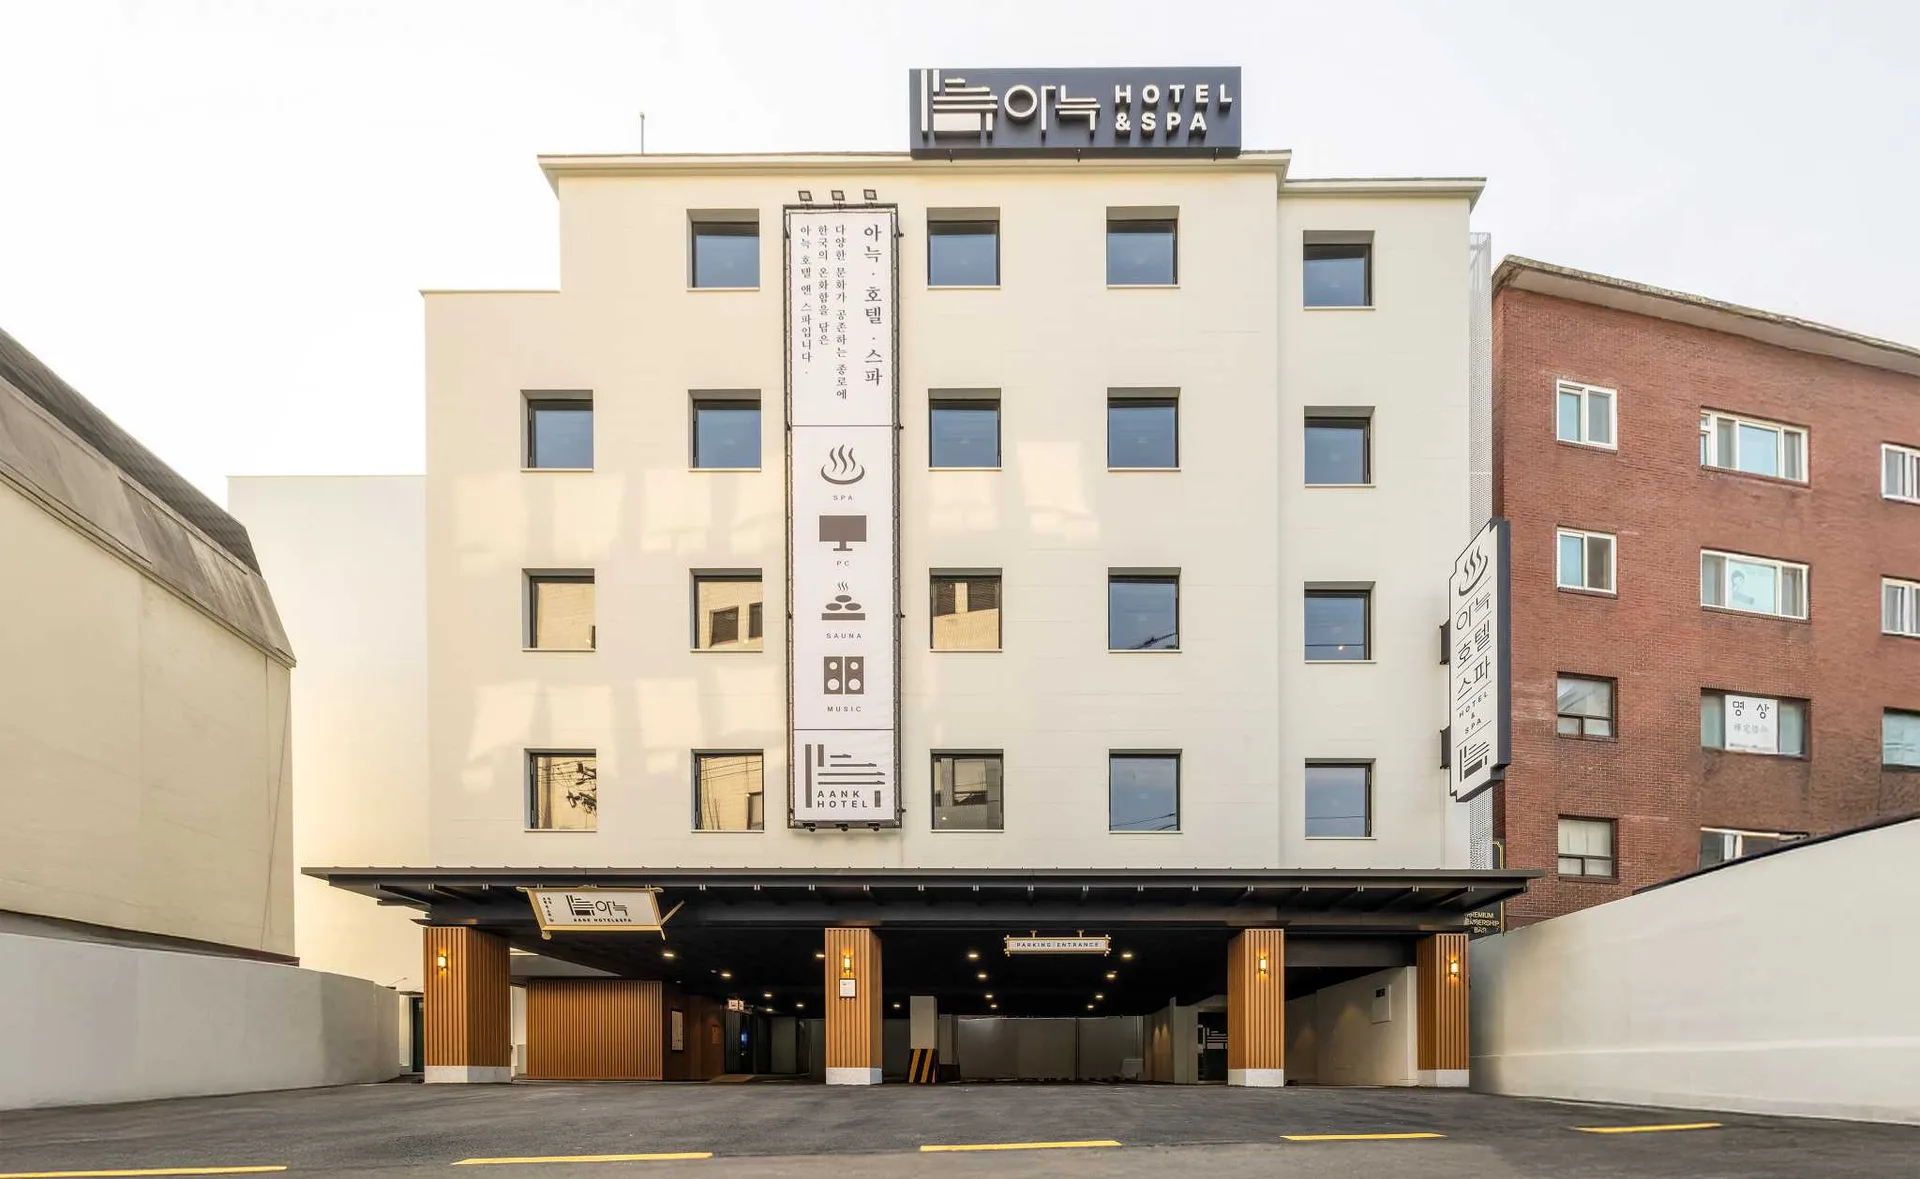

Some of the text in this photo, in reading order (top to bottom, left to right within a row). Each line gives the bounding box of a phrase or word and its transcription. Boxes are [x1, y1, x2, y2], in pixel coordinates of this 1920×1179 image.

[1114, 84, 1233, 104] HOTEL
[817, 224, 829, 261] 한국의
[835, 224, 847, 261] 다양한
[800, 254, 812, 279] 호텔
[835, 267, 847, 304] 문화가
[864, 224, 883, 386] 아늑 호텔 스파
[836, 363, 848, 400] 종로에
[1457, 592, 1490, 630] 아늑
[1457, 620, 1490, 669] 호텔
[1457, 655, 1491, 701] 스파
[1459, 691, 1488, 718] HOTEL
[1464, 718, 1482, 734] SPA
[817, 790, 860, 798] AANK
[817, 800, 868, 808] HOTEL
